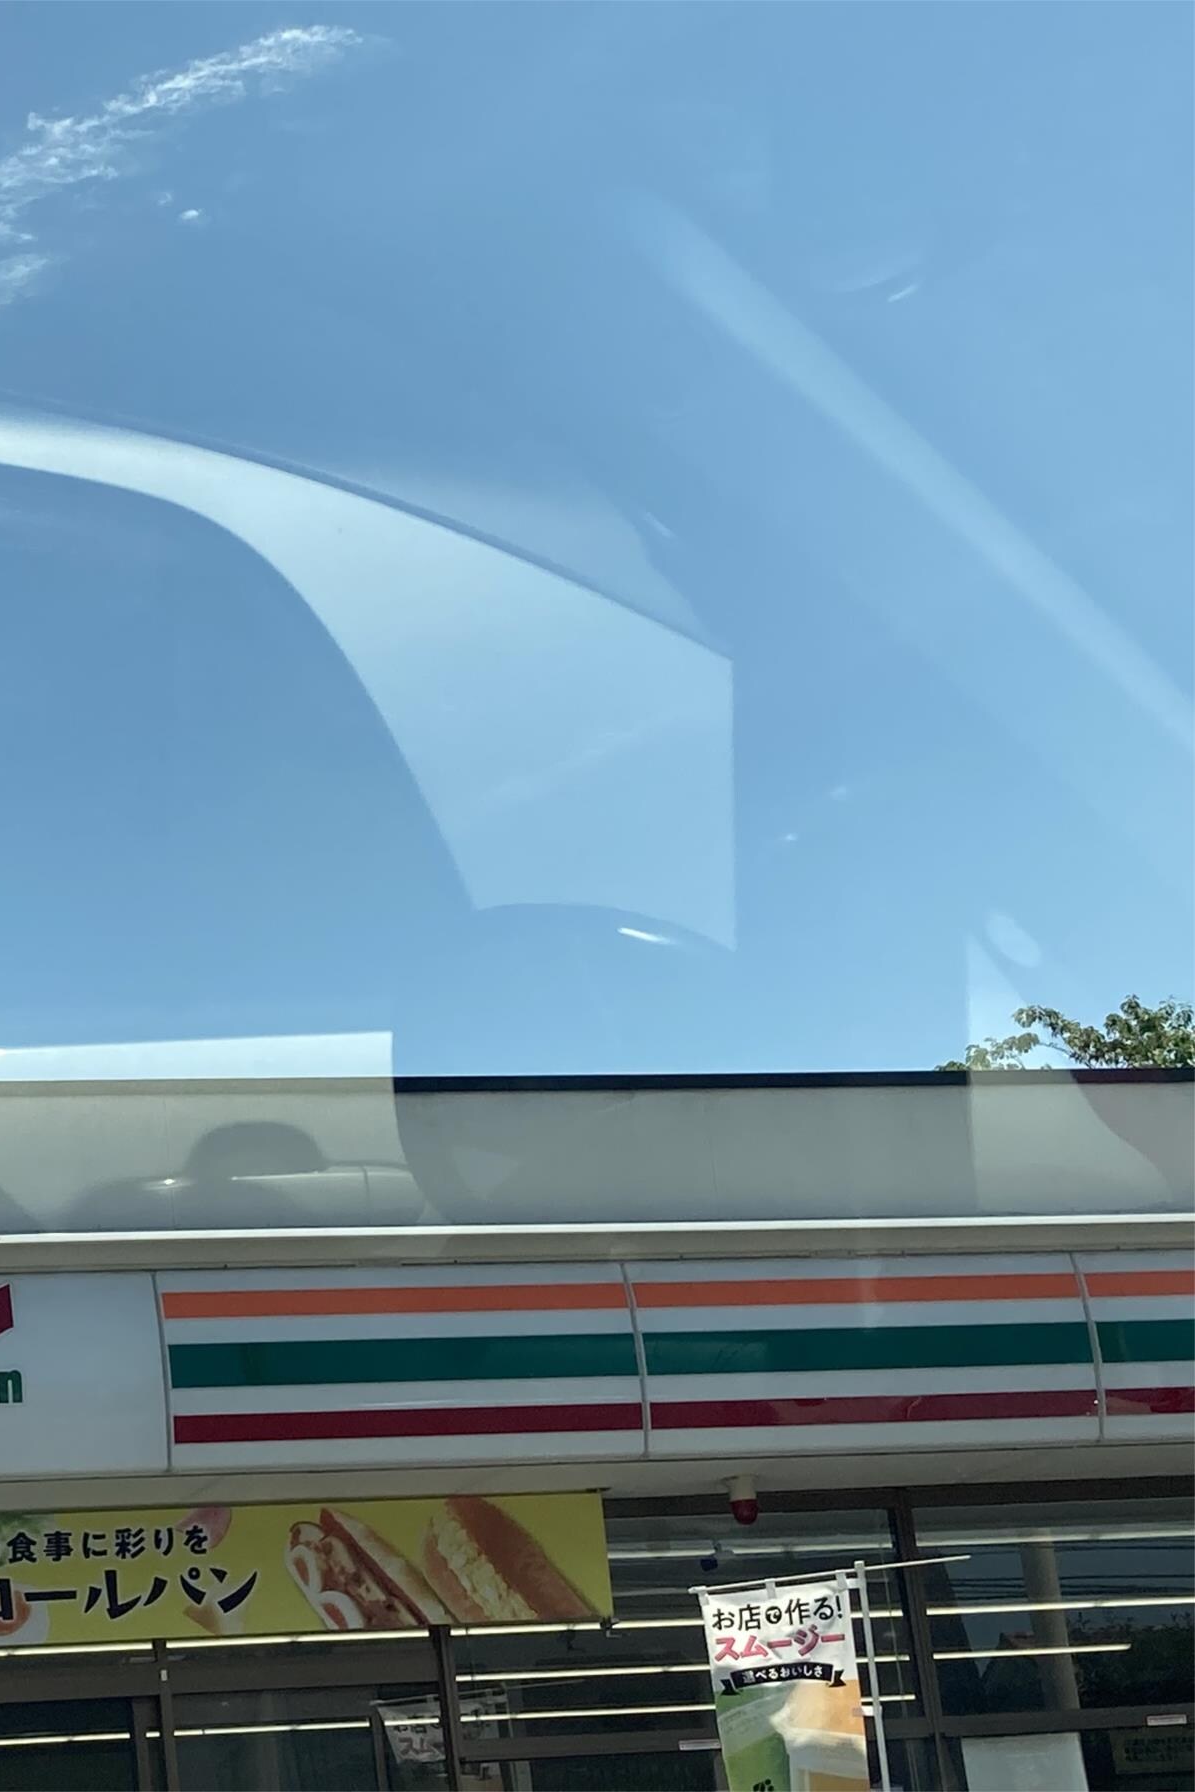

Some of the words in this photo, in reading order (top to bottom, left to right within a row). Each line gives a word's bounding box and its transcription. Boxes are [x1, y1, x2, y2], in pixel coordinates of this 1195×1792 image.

[712, 1595, 843, 1631] お店で作る!
[714, 1624, 846, 1662] スムージー
[742, 1665, 824, 1684] 選べるおいしさ
